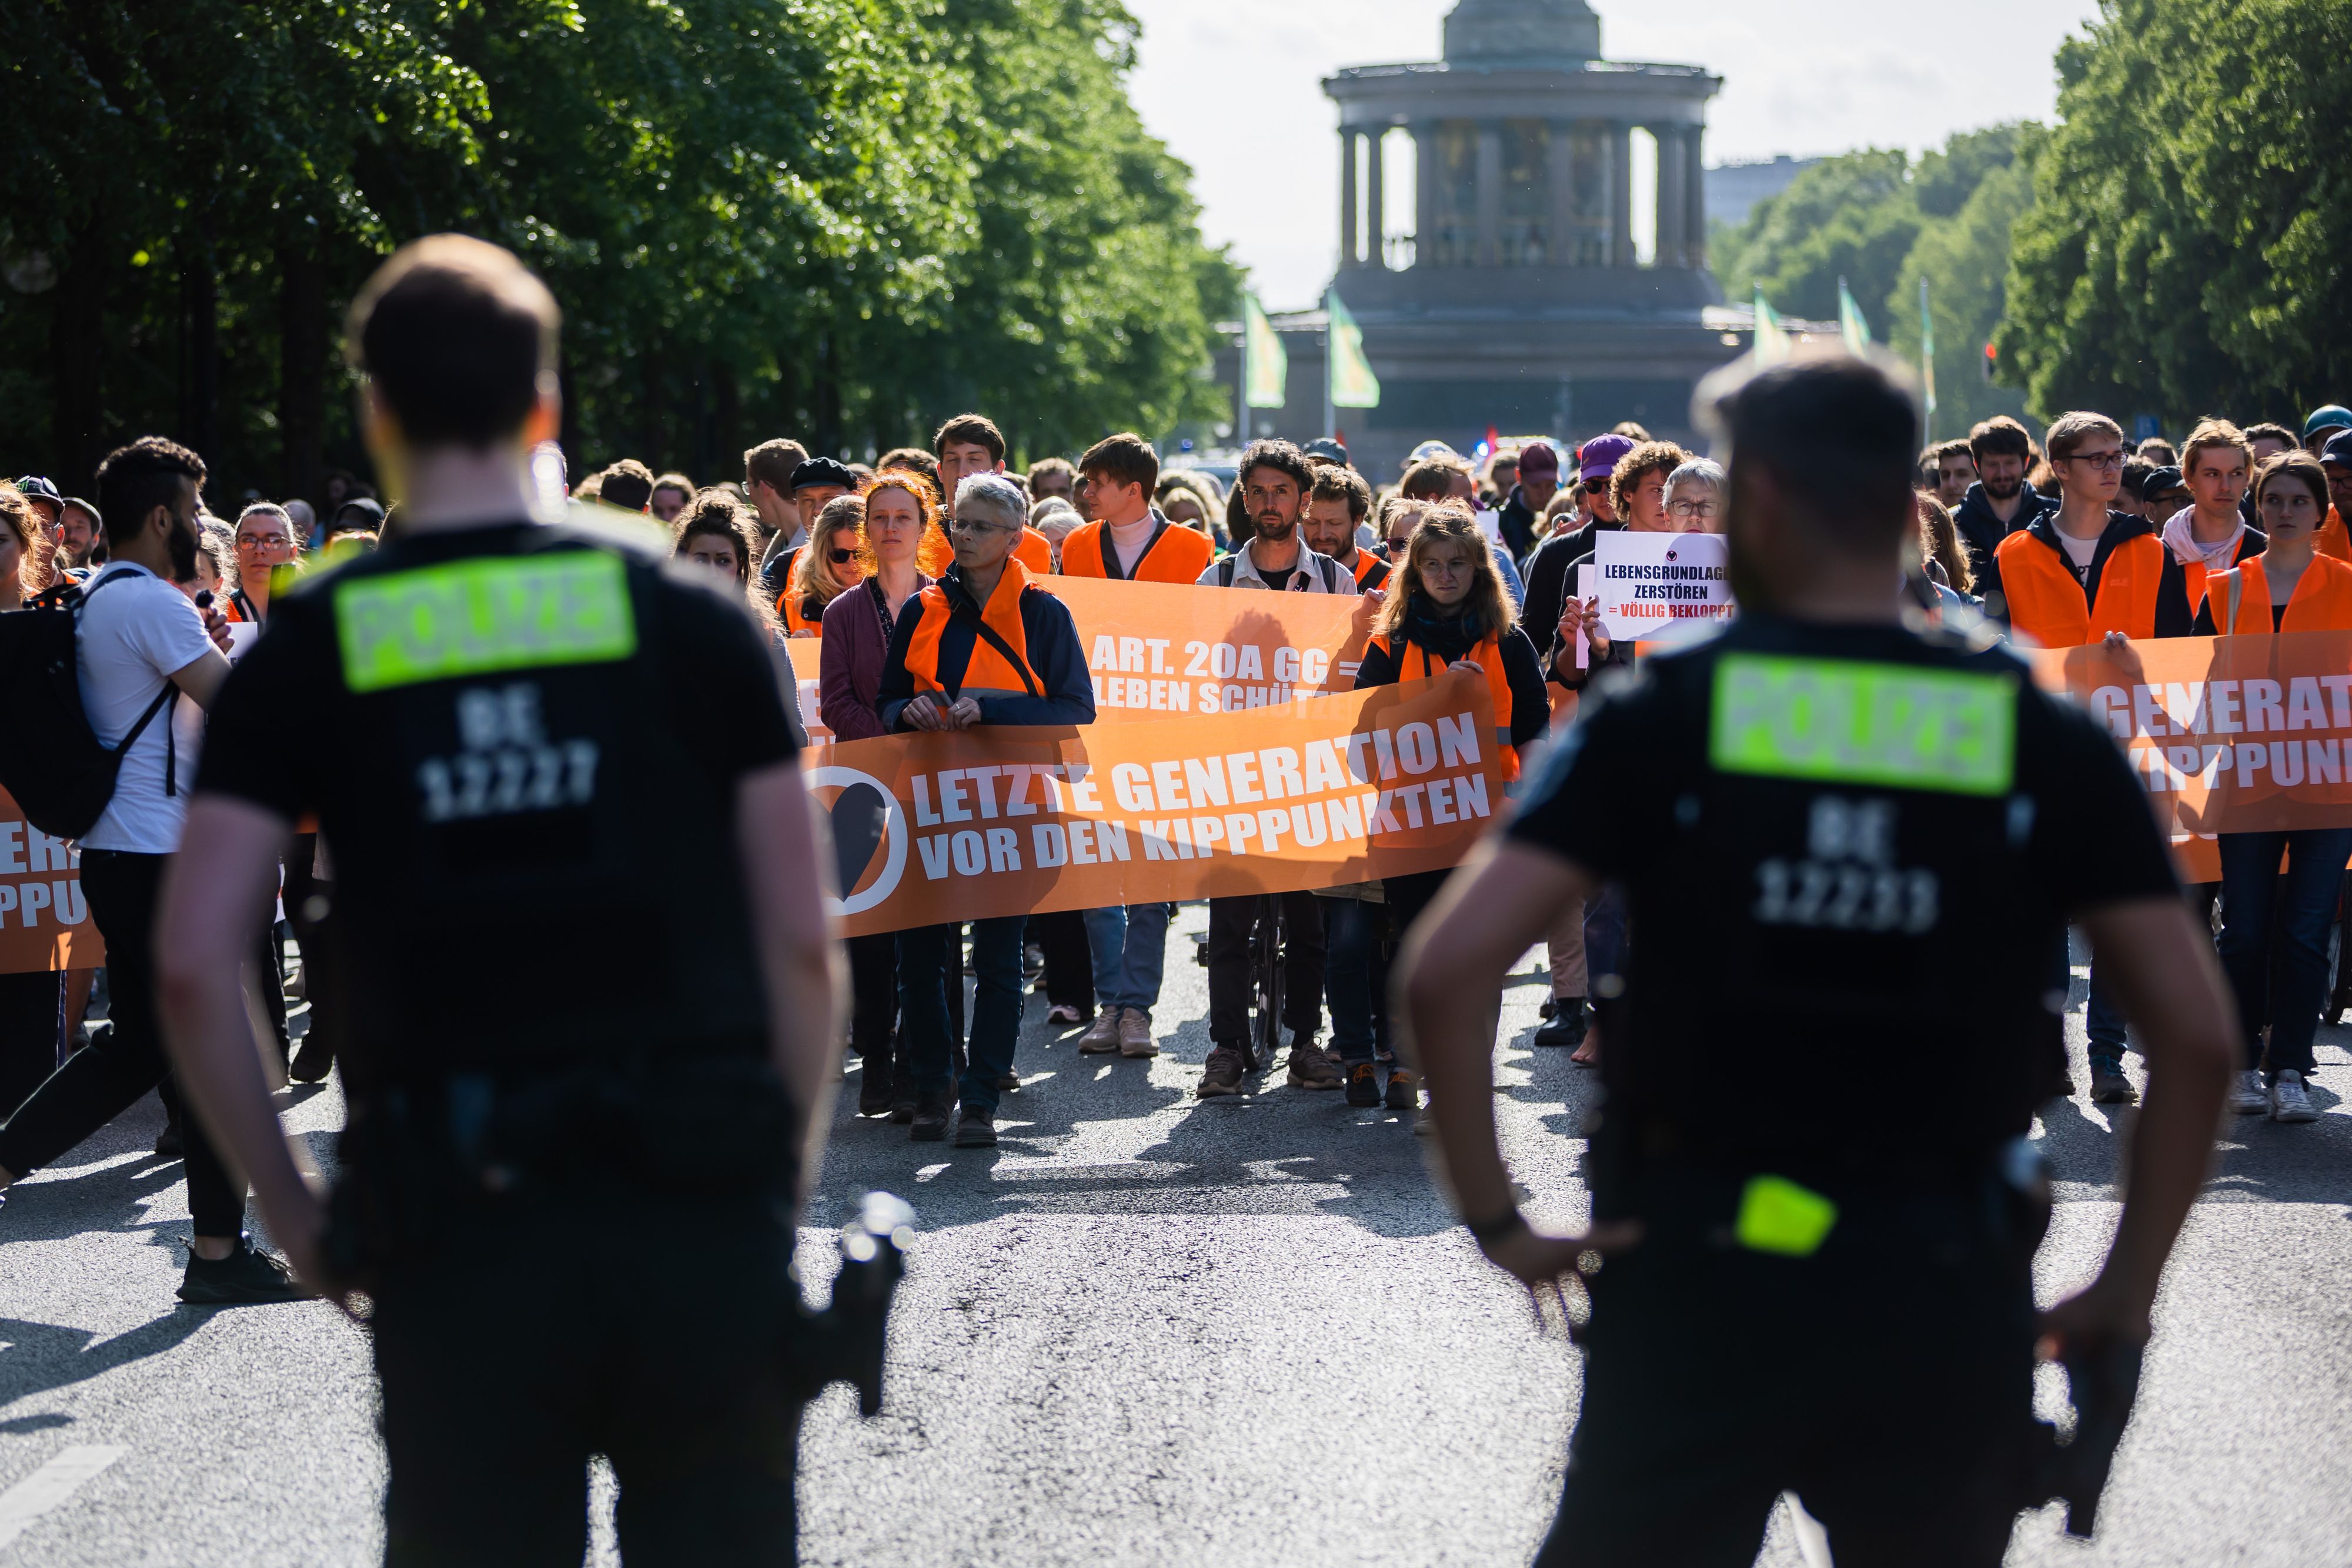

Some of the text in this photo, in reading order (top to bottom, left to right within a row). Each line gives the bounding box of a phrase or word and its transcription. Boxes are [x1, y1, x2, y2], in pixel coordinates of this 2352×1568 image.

[1621, 601, 1665, 618] VÖLLIG
[1669, 604, 1734, 618] BEKLOPPT
[1635, 583, 1708, 599] ZERSTÖREN
[344, 560, 627, 686] POLIZEI
[1091, 634, 1173, 675] ART.
[1184, 640, 1263, 680] 20A
[1274, 647, 1328, 684] GG
[1094, 676, 1190, 712] LEBEN
[1719, 661, 2007, 785] POLIZEI
[911, 712, 1481, 827] LETZTE GENERATION
[0, 821, 80, 874] ER
[917, 773, 1490, 880] VOR DEN KIPPPUNKTEN
